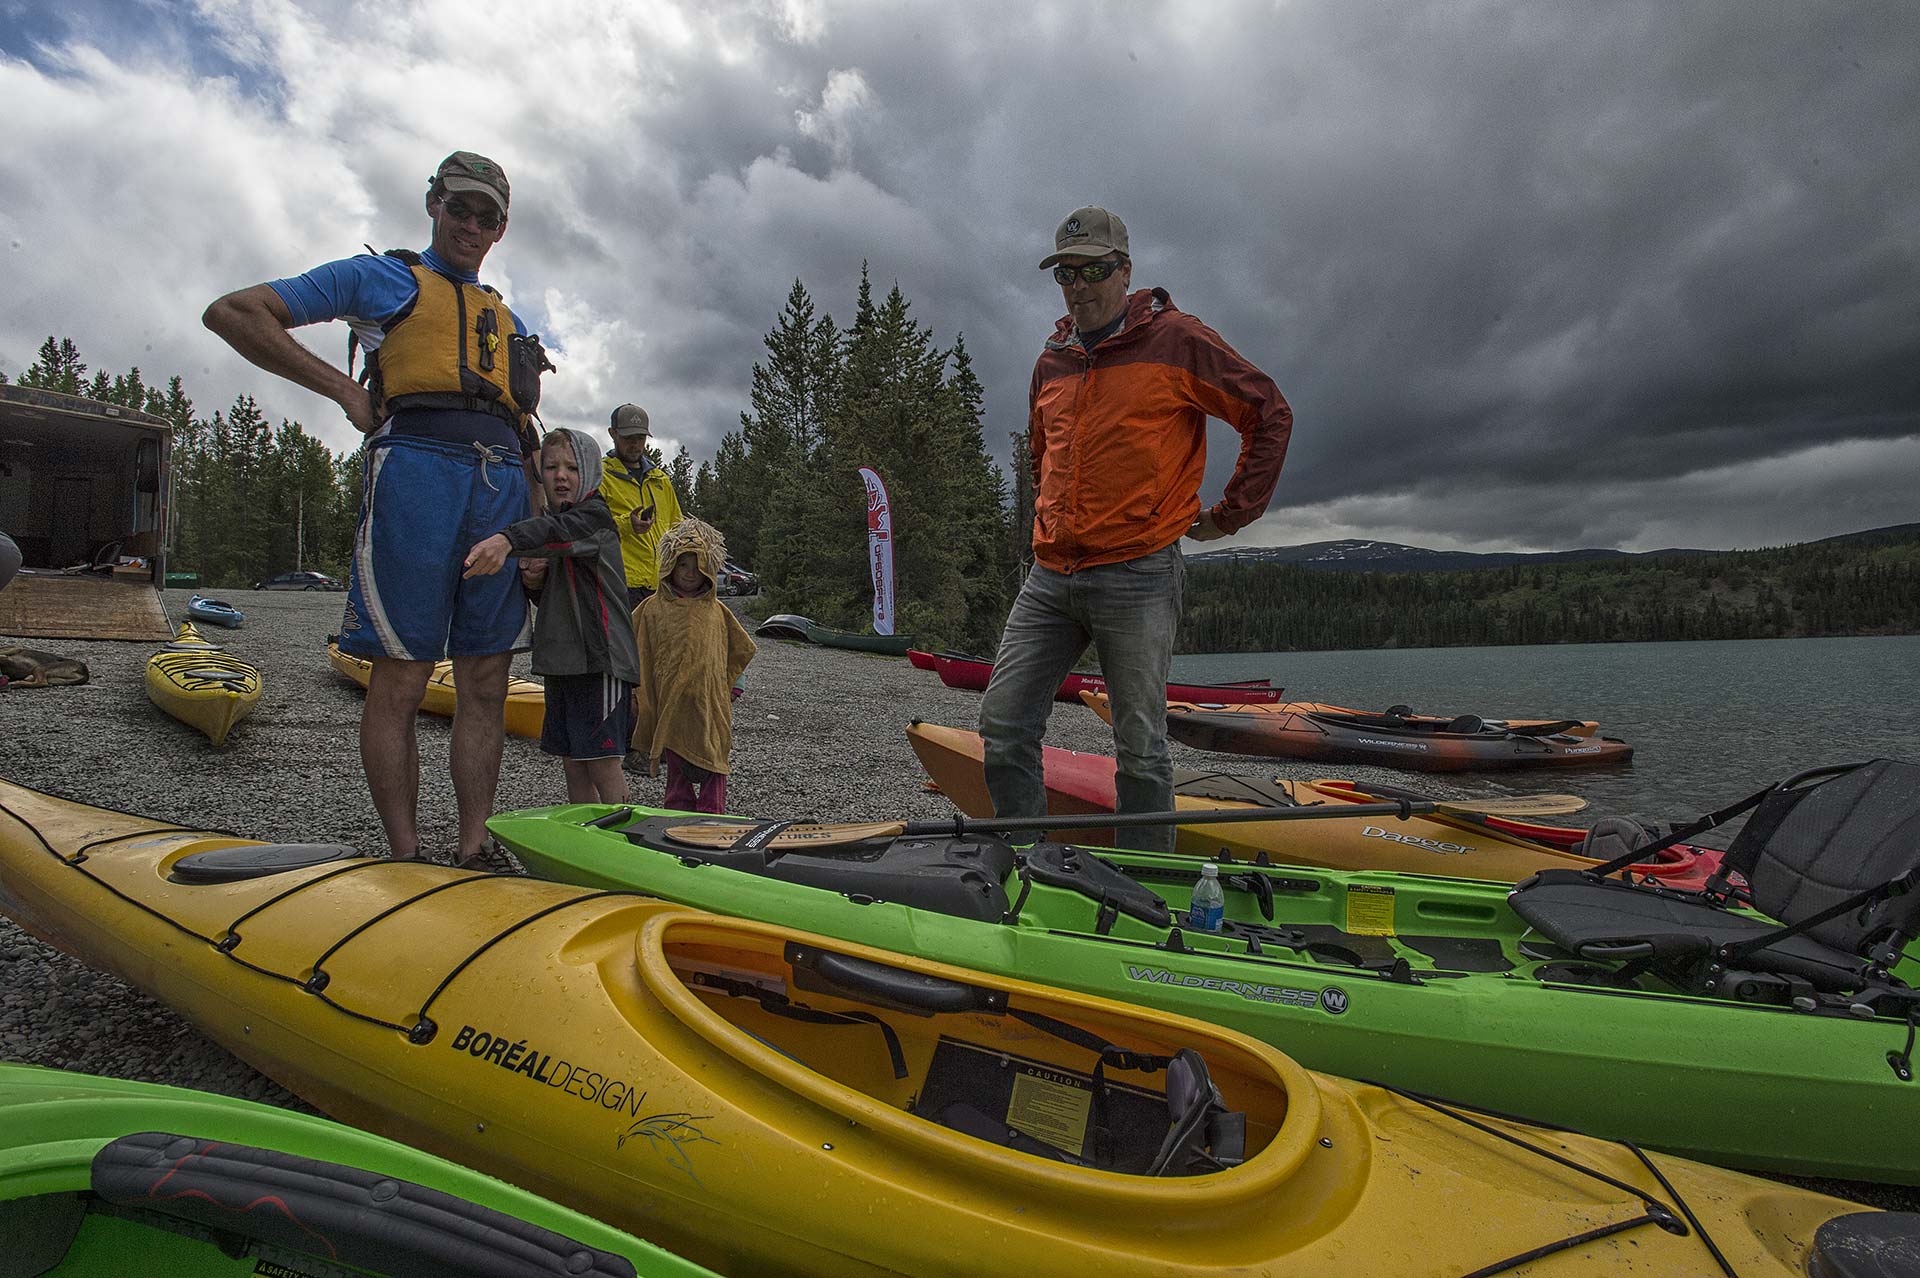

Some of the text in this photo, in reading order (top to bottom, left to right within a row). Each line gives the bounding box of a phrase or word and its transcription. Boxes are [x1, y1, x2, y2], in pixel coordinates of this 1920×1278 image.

[1362, 826, 1477, 855] Dagger
[1129, 966, 1319, 1001] WILDERNESS
[1245, 993, 1315, 1008] SYSTEMS
[1028, 1068, 1081, 1087] CAUTION
[267, 1265, 300, 1278] SAFETY
